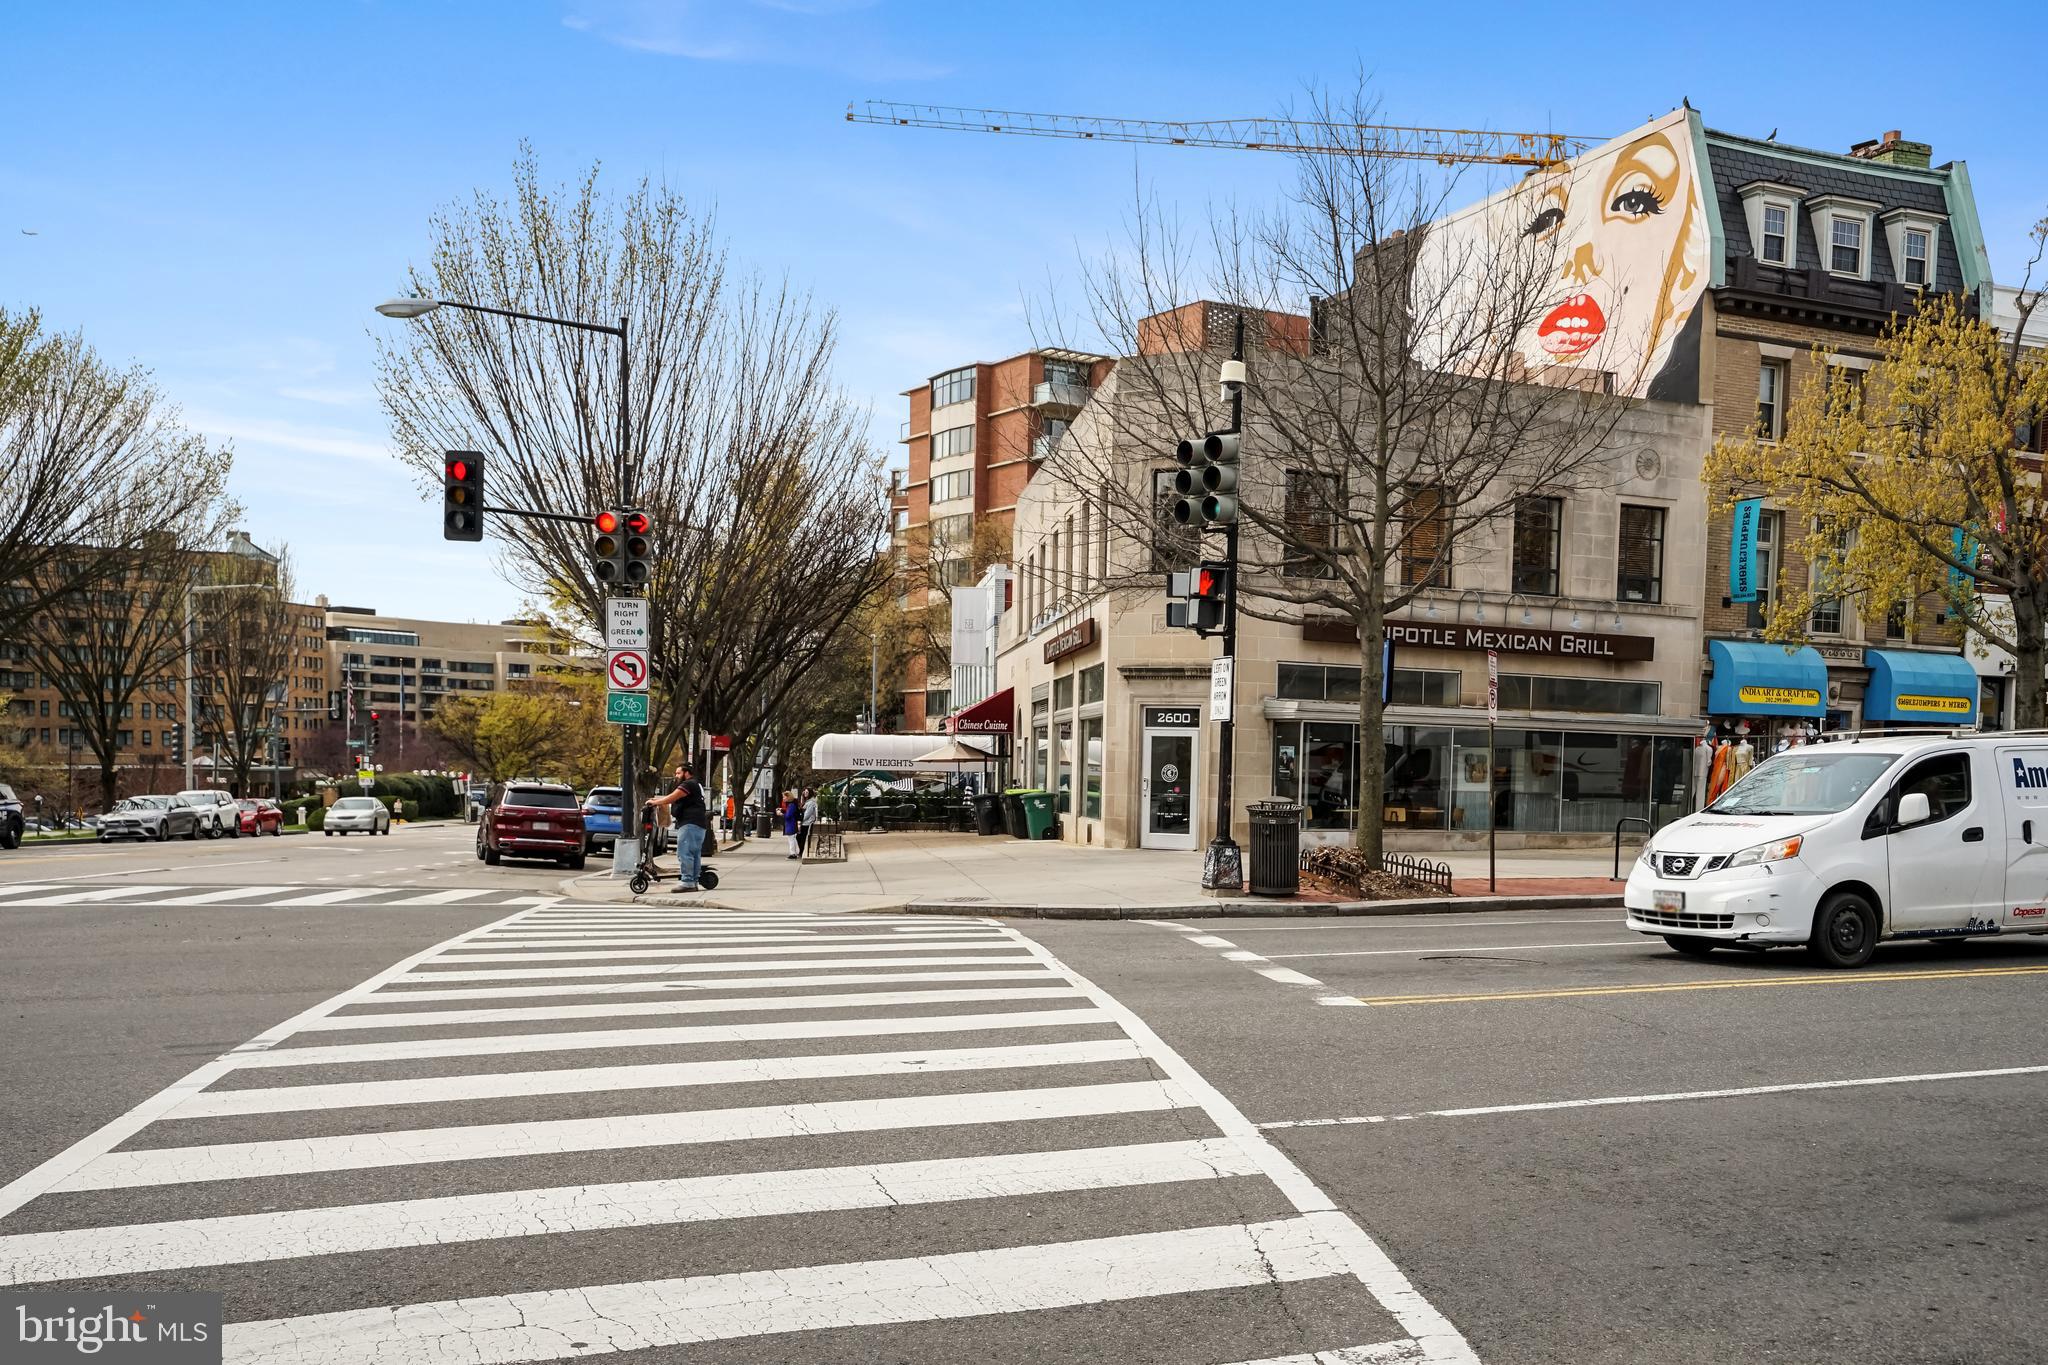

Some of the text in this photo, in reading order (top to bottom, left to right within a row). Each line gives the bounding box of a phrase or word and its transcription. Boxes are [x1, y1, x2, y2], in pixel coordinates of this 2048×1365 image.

[1738, 505, 1752, 593] SMOKEJUMPERS
[616, 601, 639, 609] TURN
[610, 628, 636, 636] GREEN
[1356, 625, 1614, 656] IPOTLE MEXICAN GRILL
[1742, 687, 1761, 696] INDIA
[1761, 688, 1775, 697] ART
[1775, 689, 1782, 697] &
[1157, 713, 1191, 723] 2600
[958, 719, 1009, 730] Chinese Cuisine
[852, 758, 914, 768] NEW HEIGHTS
[2013, 907, 2046, 918] Copesan
